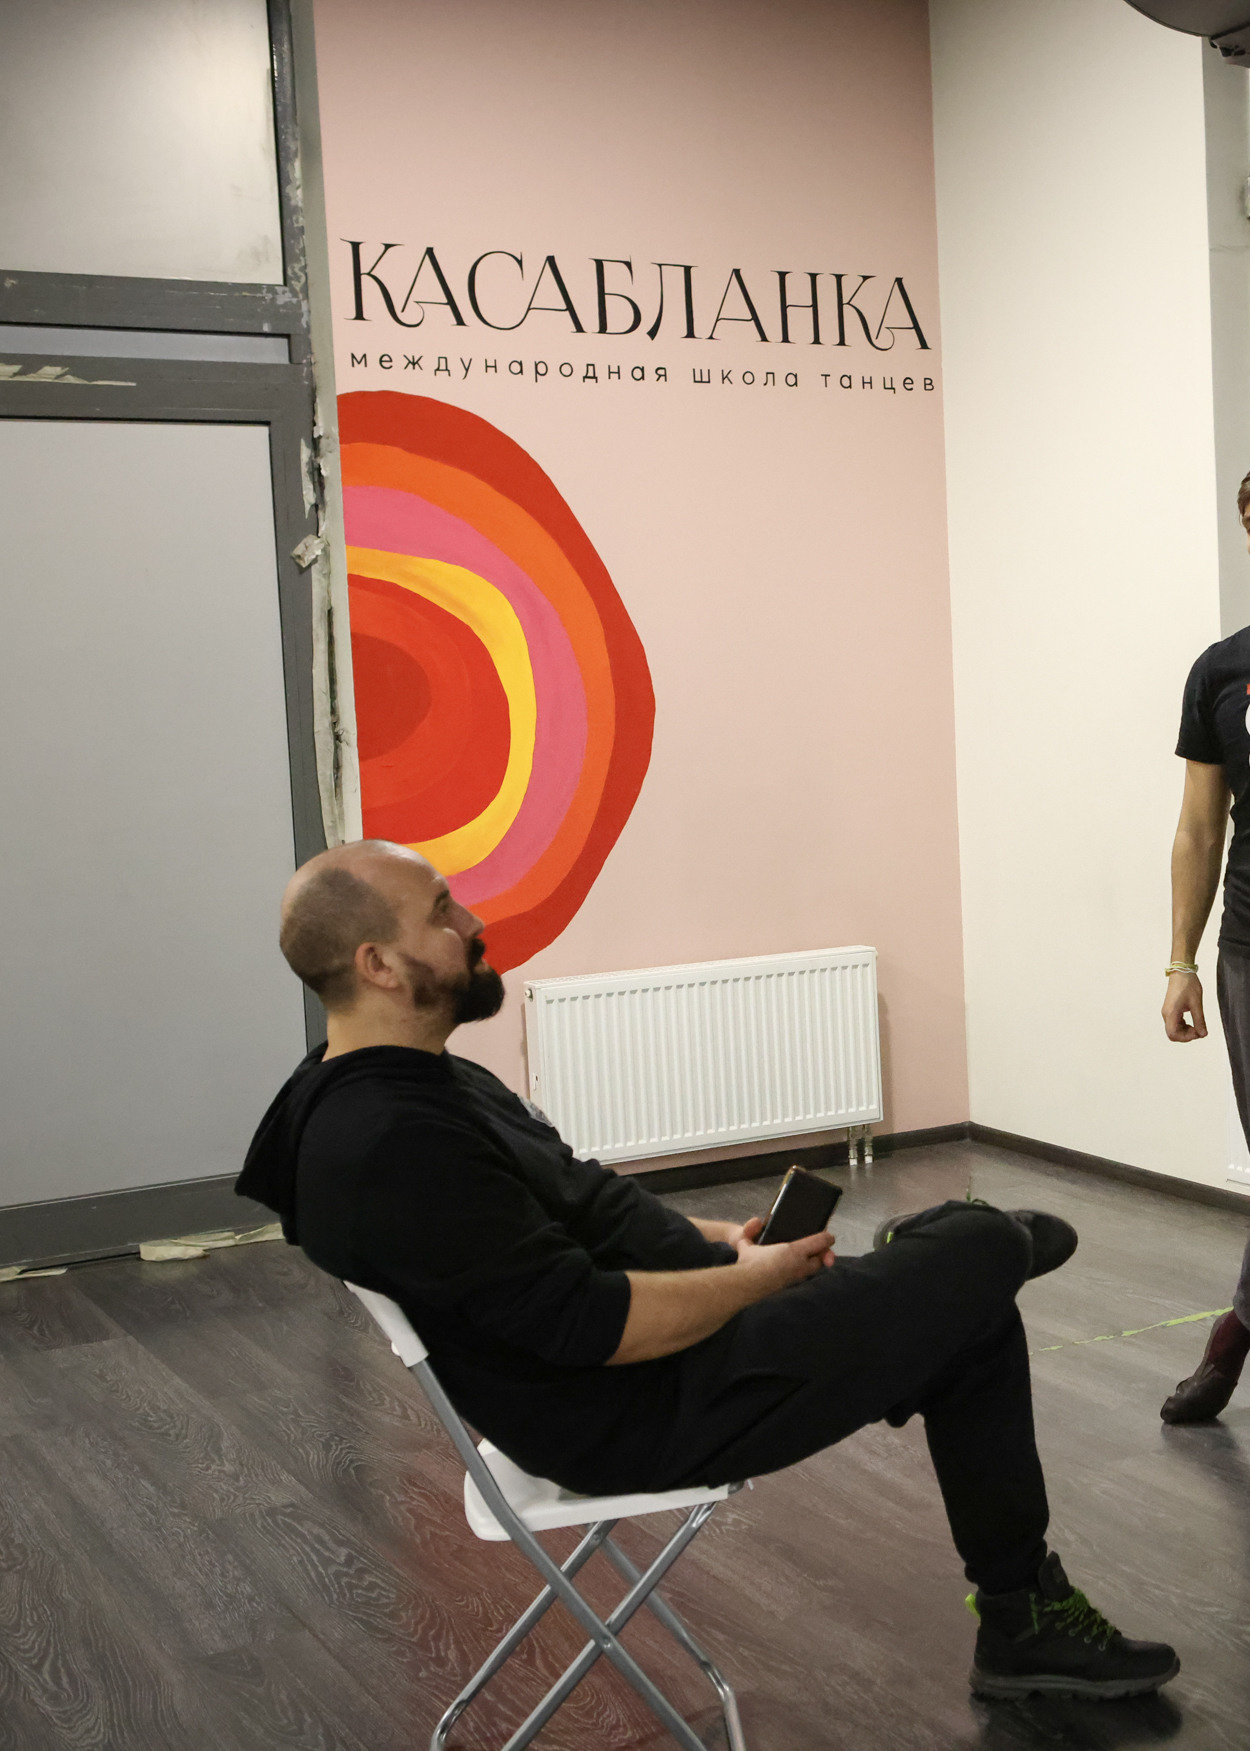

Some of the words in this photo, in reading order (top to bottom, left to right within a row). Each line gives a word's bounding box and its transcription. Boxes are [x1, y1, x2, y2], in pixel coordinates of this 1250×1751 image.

[340, 239, 932, 351] КАСАБЛАНКА
[350, 352, 668, 383] международная
[692, 367, 799, 387] школа
[820, 372, 935, 393] танцев
